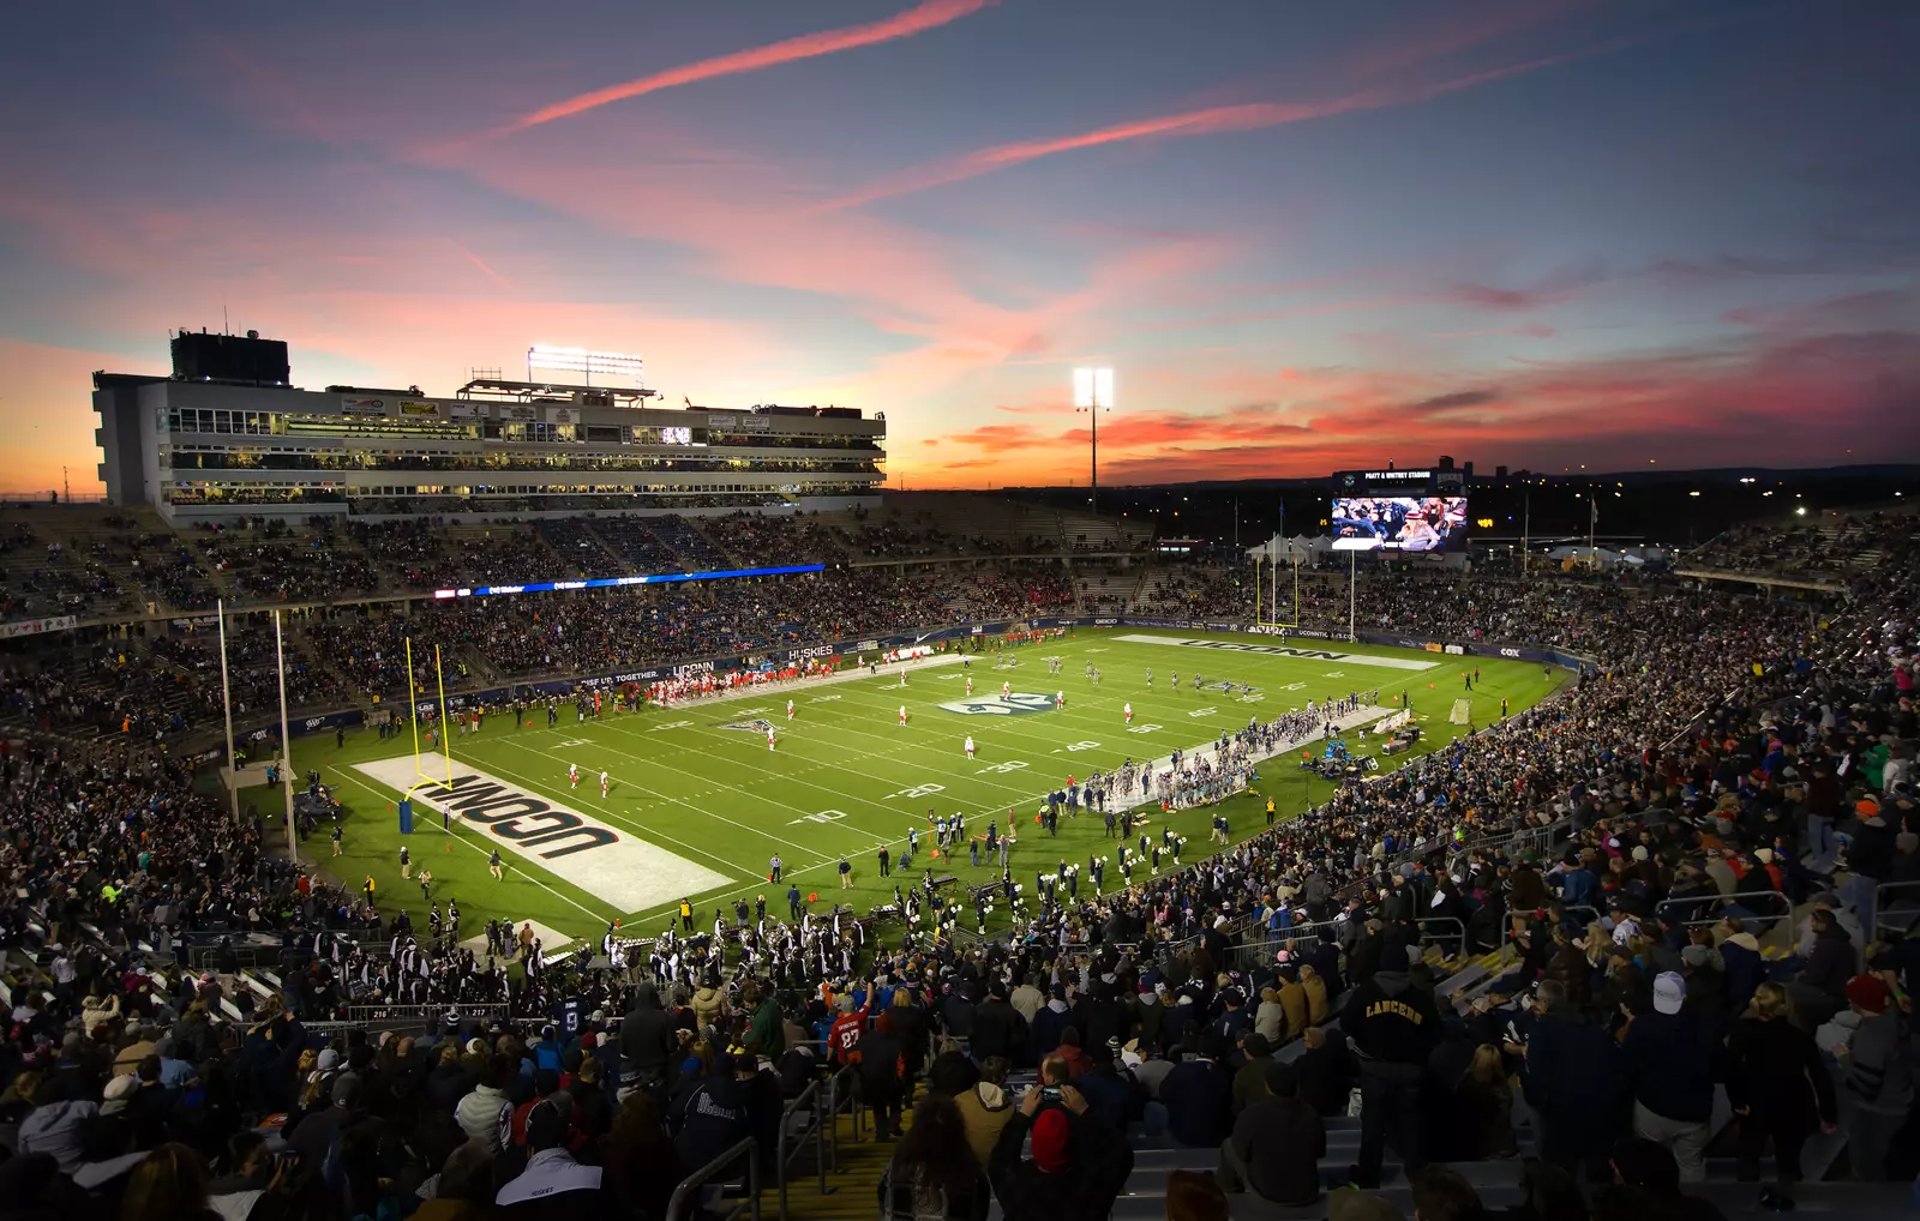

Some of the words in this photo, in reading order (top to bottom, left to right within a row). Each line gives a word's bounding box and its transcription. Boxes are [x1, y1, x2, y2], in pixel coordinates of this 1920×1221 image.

[1408, 471, 1430, 479] STADIUM
[788, 645, 833, 660] HUSKIES
[1500, 648, 1520, 657] COX
[408, 774, 619, 860] UCONN
[841, 1029, 859, 1049] 87
